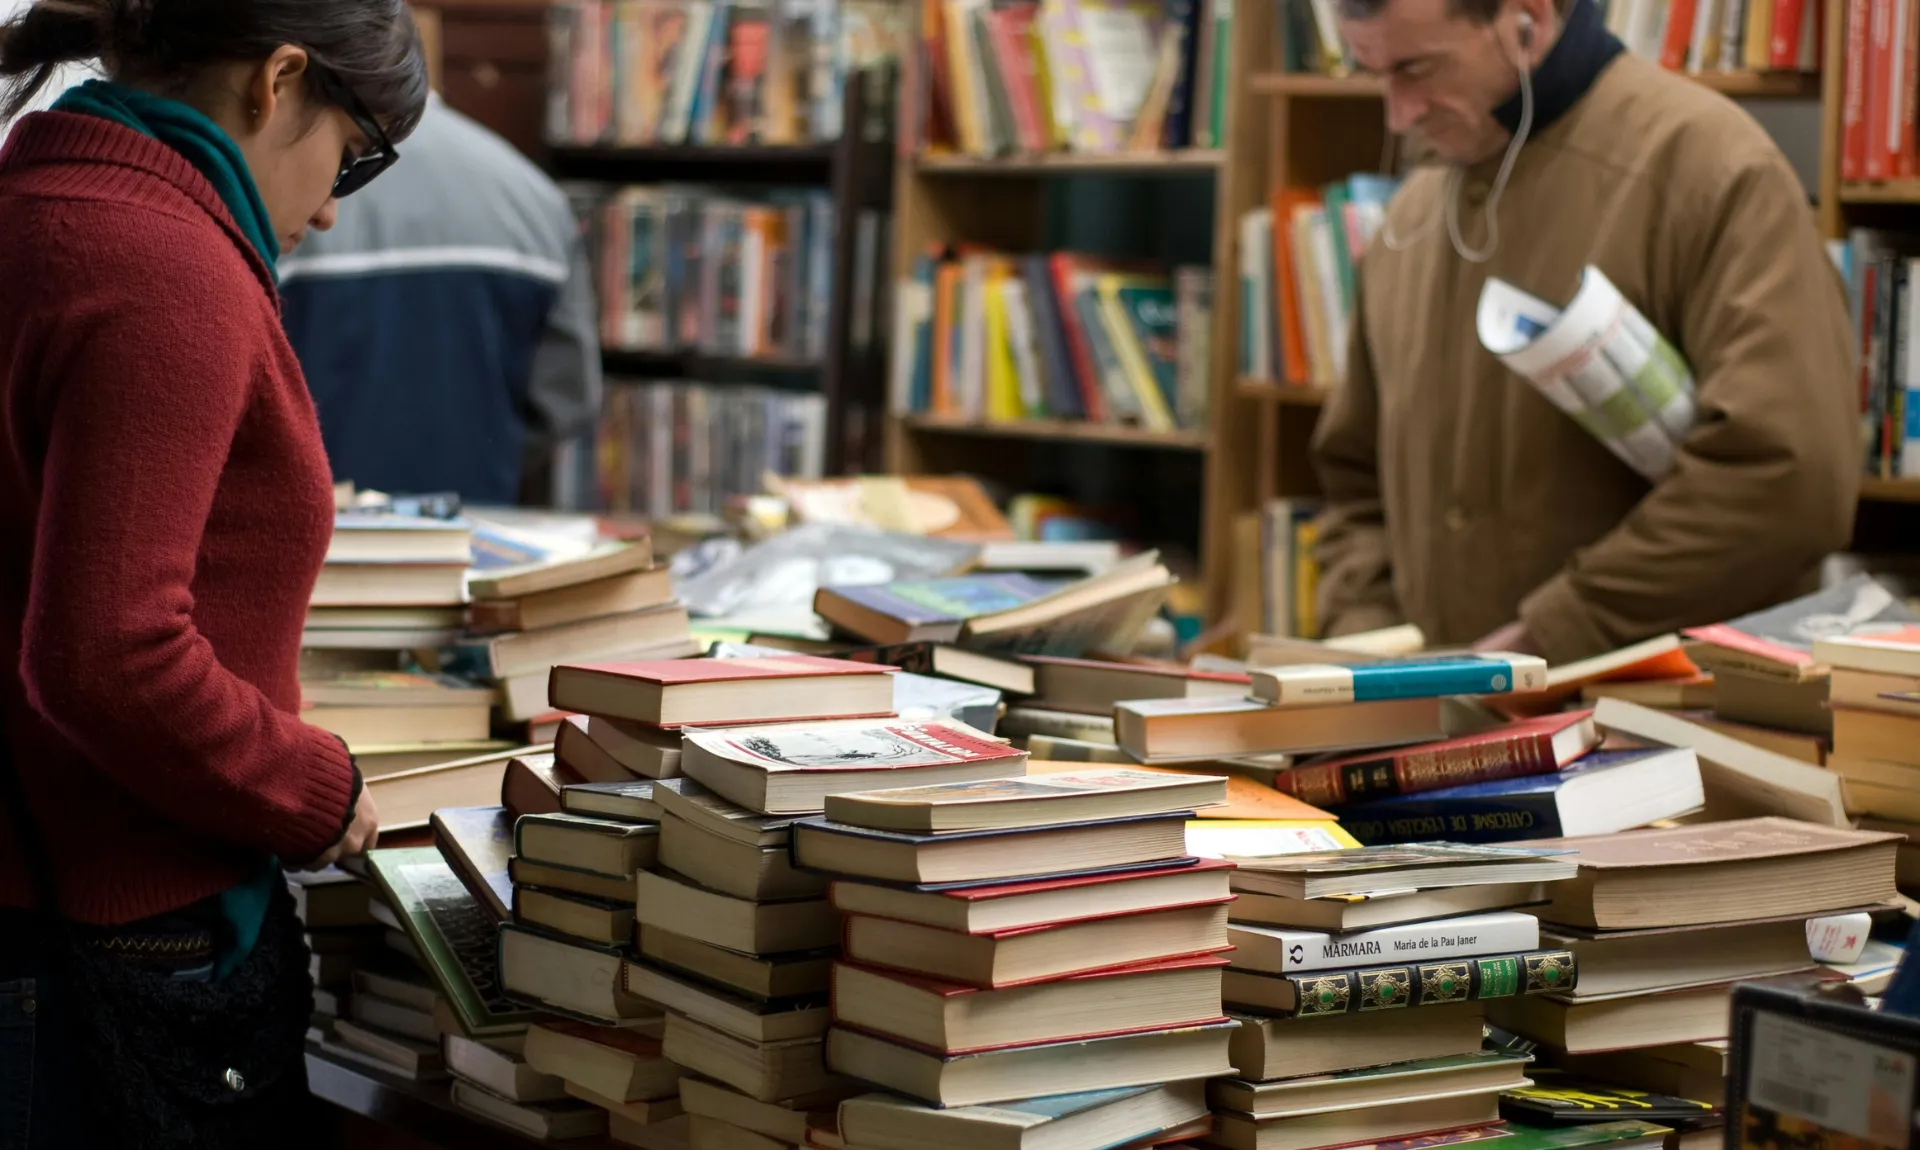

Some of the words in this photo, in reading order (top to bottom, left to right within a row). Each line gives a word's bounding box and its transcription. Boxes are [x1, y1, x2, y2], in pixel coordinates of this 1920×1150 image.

[1451, 815, 1466, 831] DE
[1473, 811, 1533, 830] CATECISME
[1322, 941, 1381, 959] MÀRMARA
[1393, 939, 1417, 951] Maria
[1418, 937, 1429, 949] de
[1431, 936, 1439, 948] la
[1440, 936, 1455, 947] Pau
[1456, 935, 1478, 946] Janer
